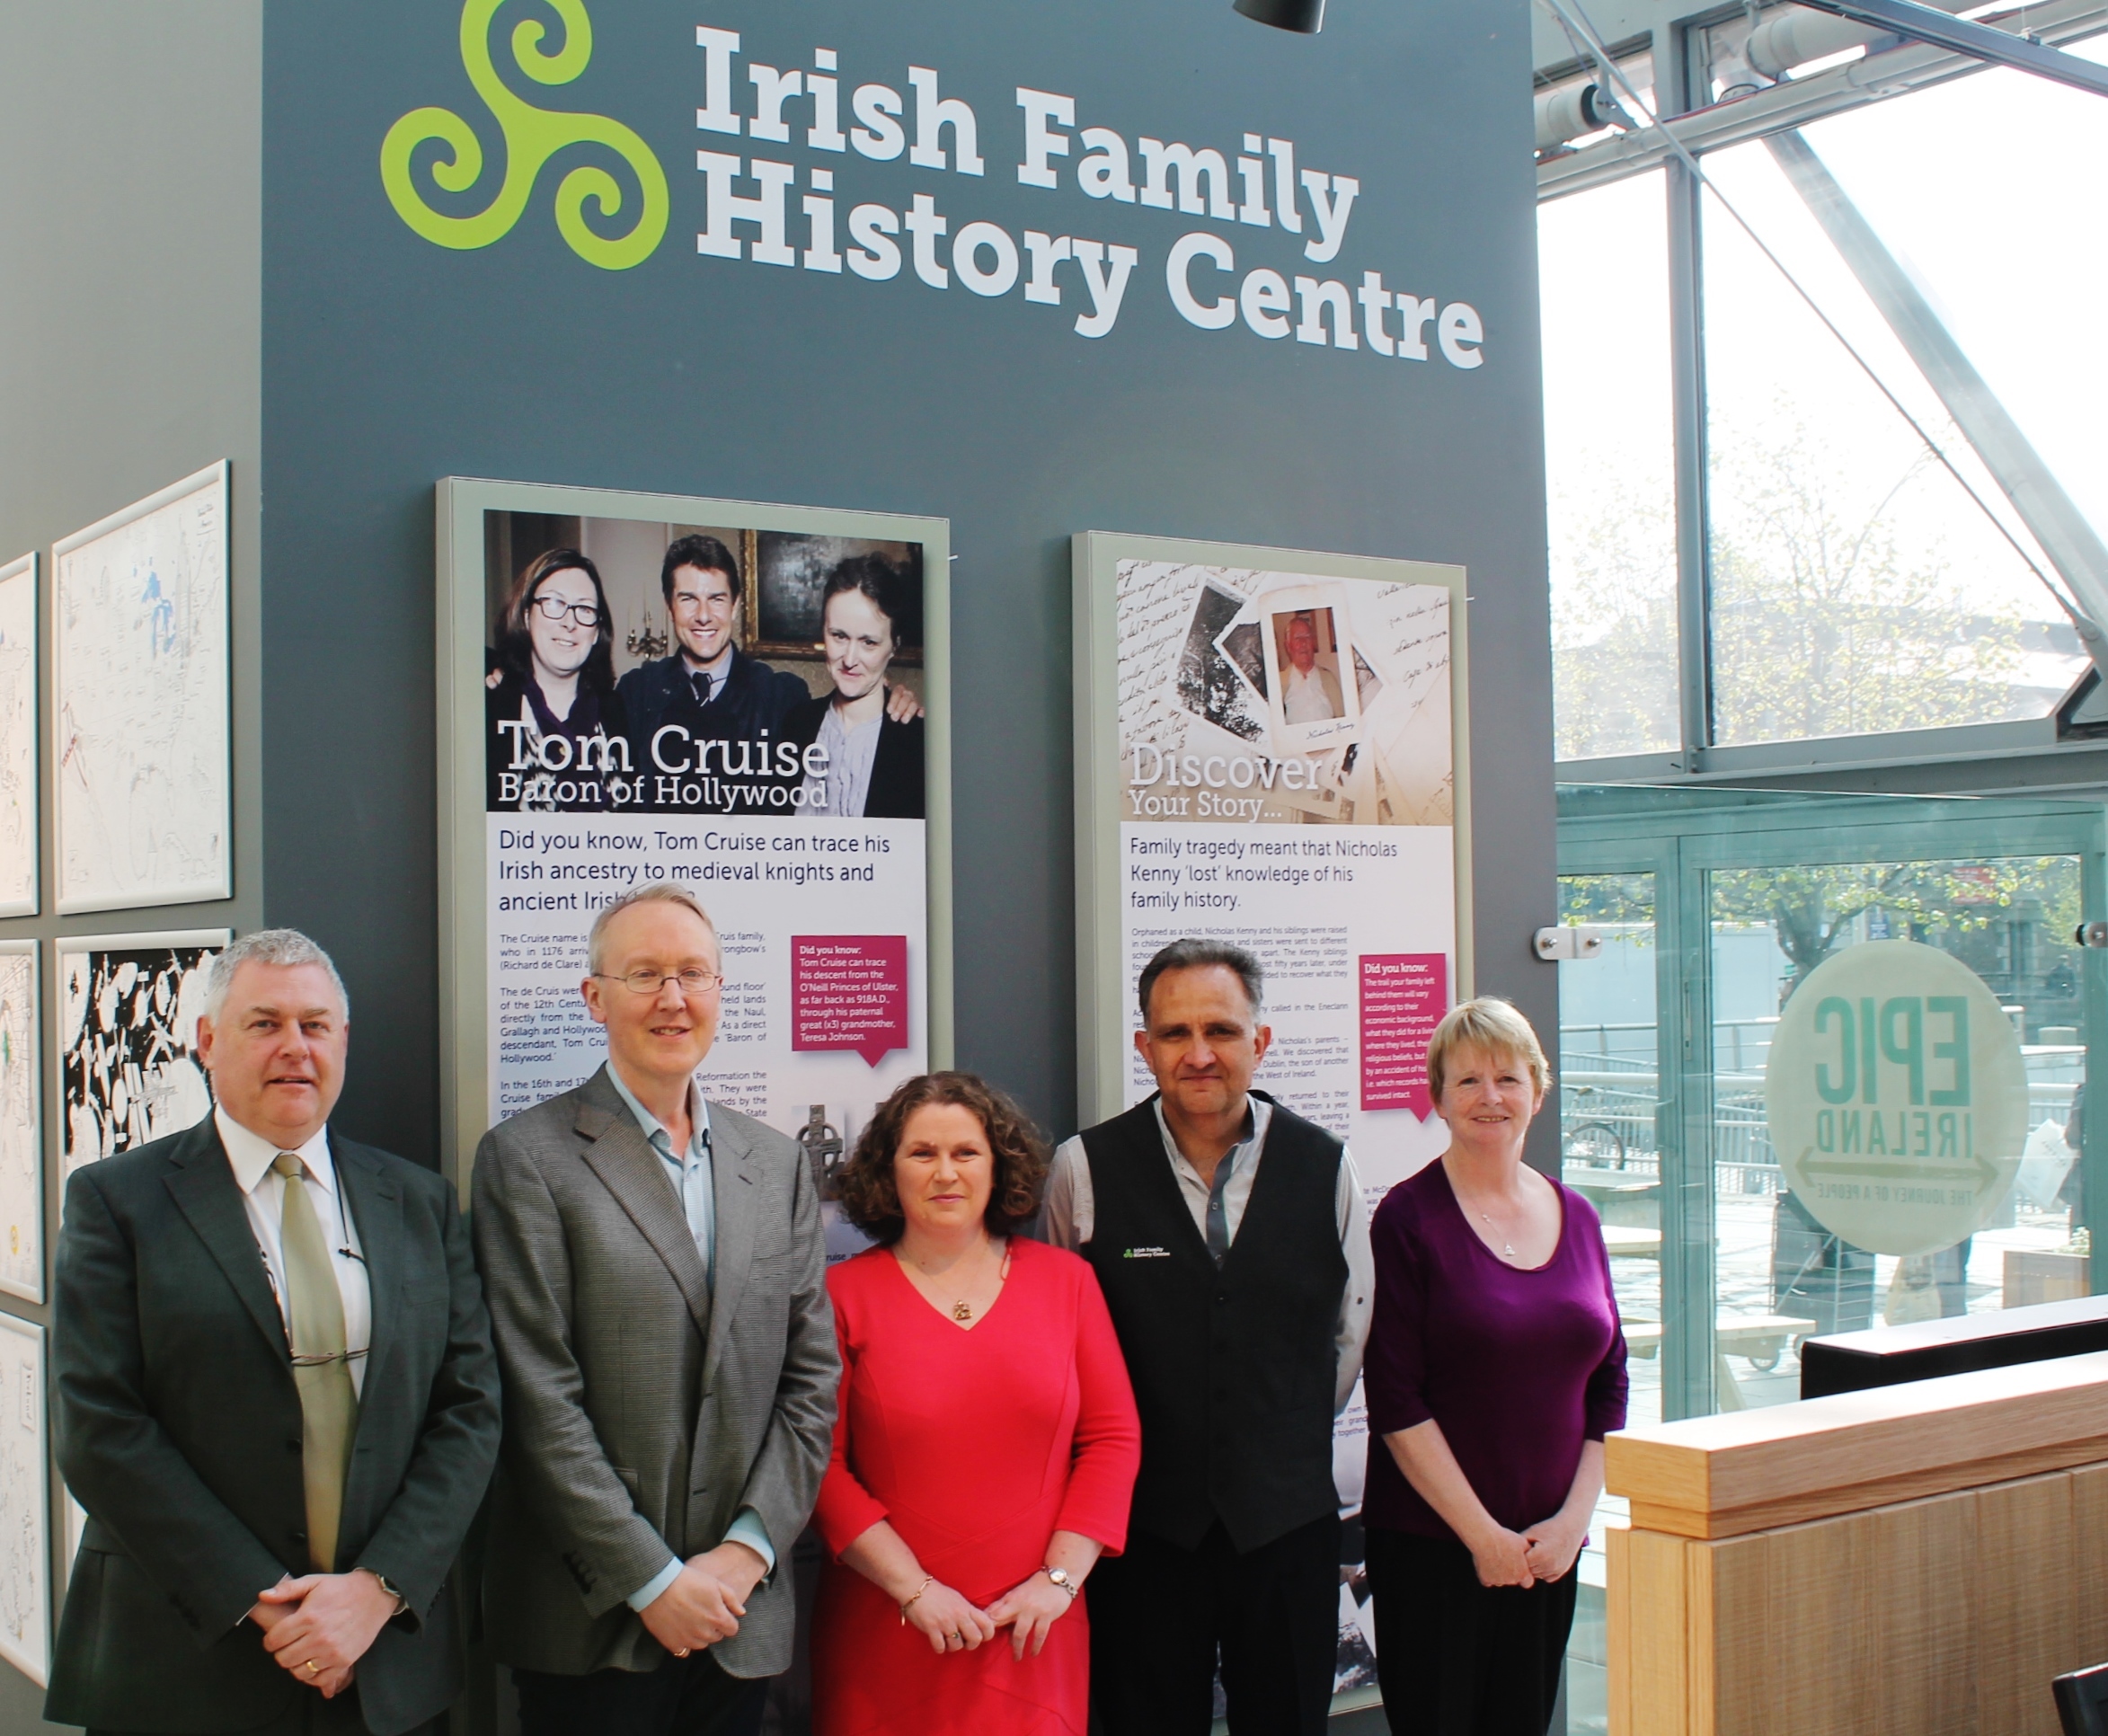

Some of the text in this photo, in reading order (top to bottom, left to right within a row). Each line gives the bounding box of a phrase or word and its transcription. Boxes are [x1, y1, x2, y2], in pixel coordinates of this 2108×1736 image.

[695, 24, 1360, 263] Irish Family
[695, 150, 1484, 370] History Centre
[498, 719, 830, 778] Tom Cruise
[1129, 741, 1323, 791] Discover
[498, 774, 828, 813] Baron of Hollywood
[1128, 789, 1283, 823] Your Story...
[500, 829, 890, 855] Did you know, Tom Cruise can trace his
[1130, 837, 1398, 859] Family tragedy meant that Nicholas
[500, 861, 873, 885] Irish ancestry to medieval knights and
[1130, 864, 1181, 885] Kenny
[1226, 865, 1310, 885] knowledge
[1313, 866, 1330, 881] of
[1333, 866, 1353, 881] his
[499, 891, 578, 911] ancient
[1131, 891, 1241, 911] family history.
[500, 932, 766, 943] The Cruise name is family,
[500, 946, 563, 957] who in 1176
[799, 945, 862, 956] Did you know:
[500, 960, 582, 970] (Richard de Clare)
[799, 958, 887, 967] Tom Cruise can trace
[1364, 963, 1381, 974] Did
[1381, 964, 1400, 976] you
[799, 970, 884, 979] his descent from the
[500, 988, 518, 996] The
[520, 987, 533, 996] de
[535, 987, 559, 996] Cruis
[829, 982, 861, 991] Princes
[861, 982, 872, 991] of
[500, 995, 766, 1010] of the 12th held lands
[800, 996, 810, 1005] as
[810, 996, 822, 1004] far
[824, 996, 845, 1004] back
[500, 1013, 536, 1024] directly
[540, 1012, 563, 1022] from
[569, 1012, 584, 1021] the
[724, 1008, 740, 1016] the
[800, 1007, 883, 1018] through his paternal
[500, 1026, 539, 1038] Grallagh
[543, 1026, 560, 1035] and
[721, 1021, 731, 1030] As
[741, 1021, 766, 1029] direct
[800, 1021, 822, 1032] great
[500, 1041, 557, 1050] descendant,
[562, 1038, 583, 1048] Tom
[757, 1032, 767, 1041] of
[800, 1032, 828, 1042] Teresa
[500, 1081, 509, 1090] In
[513, 1080, 528, 1089] the
[531, 1079, 552, 1088] 16th
[554, 1078, 572, 1087] and
[752, 1071, 767, 1079] the
[500, 1094, 530, 1103] Cruise
[719, 1084, 740, 1094] They
[739, 1096, 767, 1107] by the
